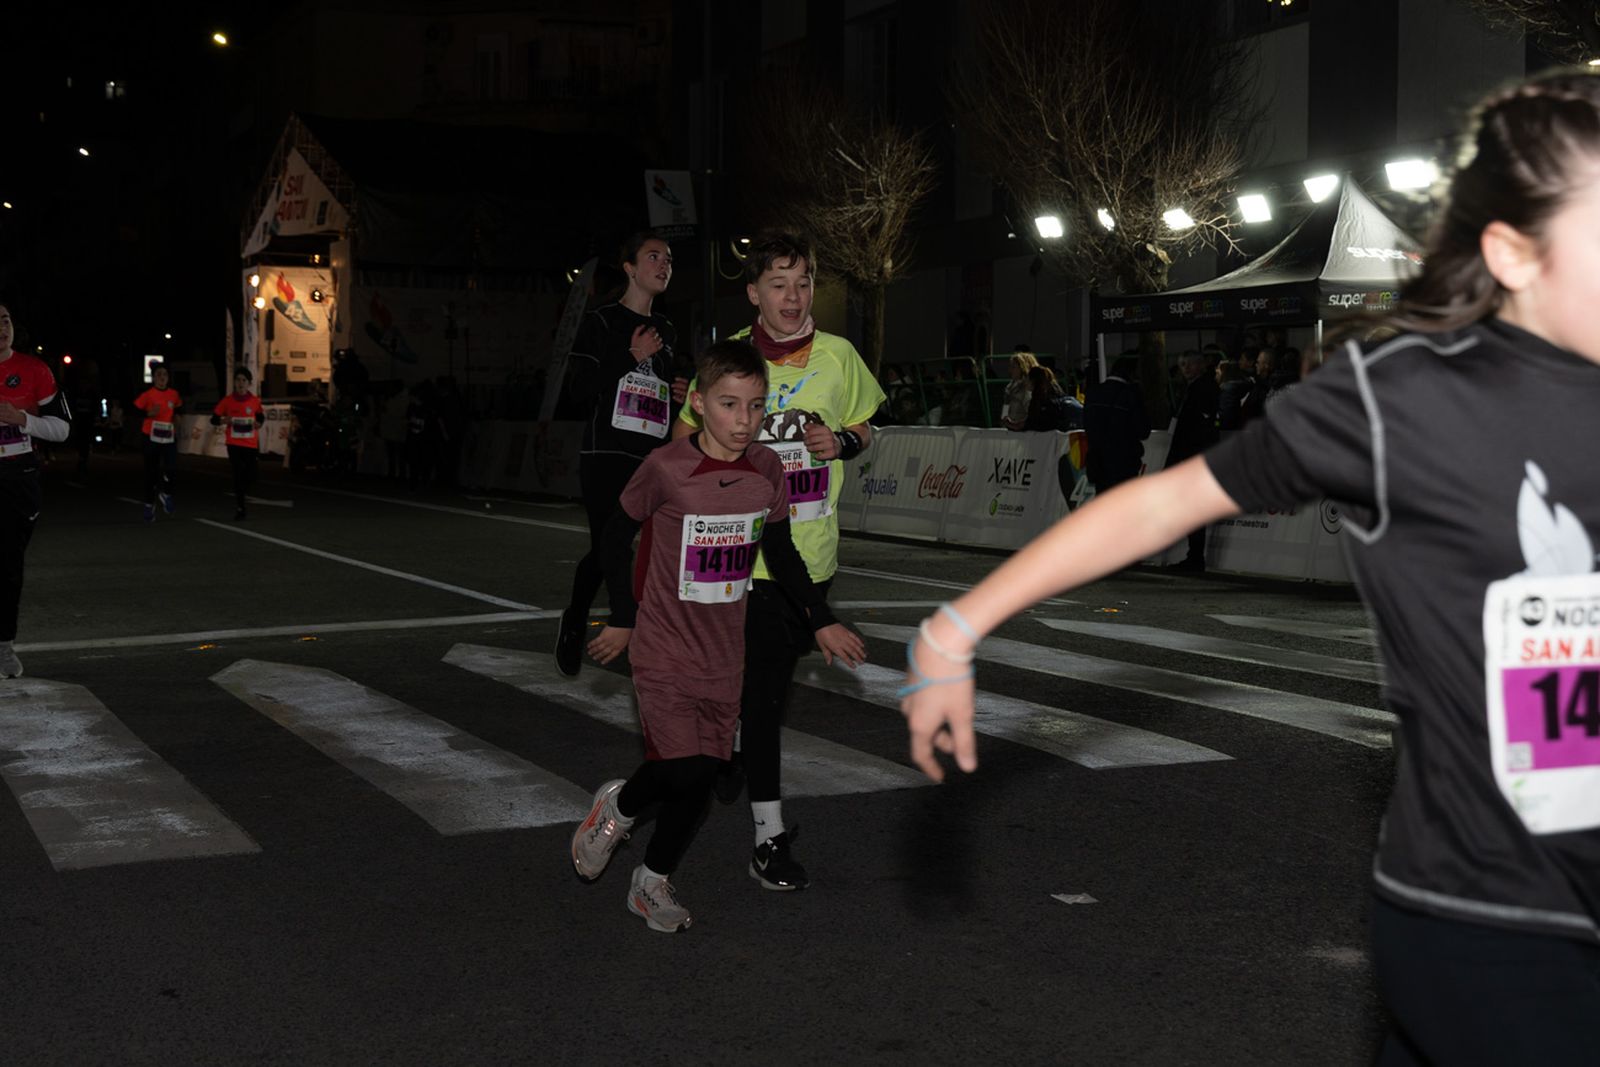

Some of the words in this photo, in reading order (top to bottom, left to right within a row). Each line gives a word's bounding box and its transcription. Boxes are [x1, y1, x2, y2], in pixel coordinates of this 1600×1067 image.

[783, 461, 803, 471] NTÓN
[793, 451, 803, 460] DE
[787, 469, 821, 496] 107
[988, 457, 1036, 486] XAVE
[862, 474, 897, 499] aqualia
[706, 525, 734, 534] NOCHE
[736, 524, 746, 533] DE
[694, 536, 714, 545] SAN
[1553, 606, 1600, 627] NOC
[1521, 638, 1573, 661] SAN
[1531, 669, 1600, 741] 14
